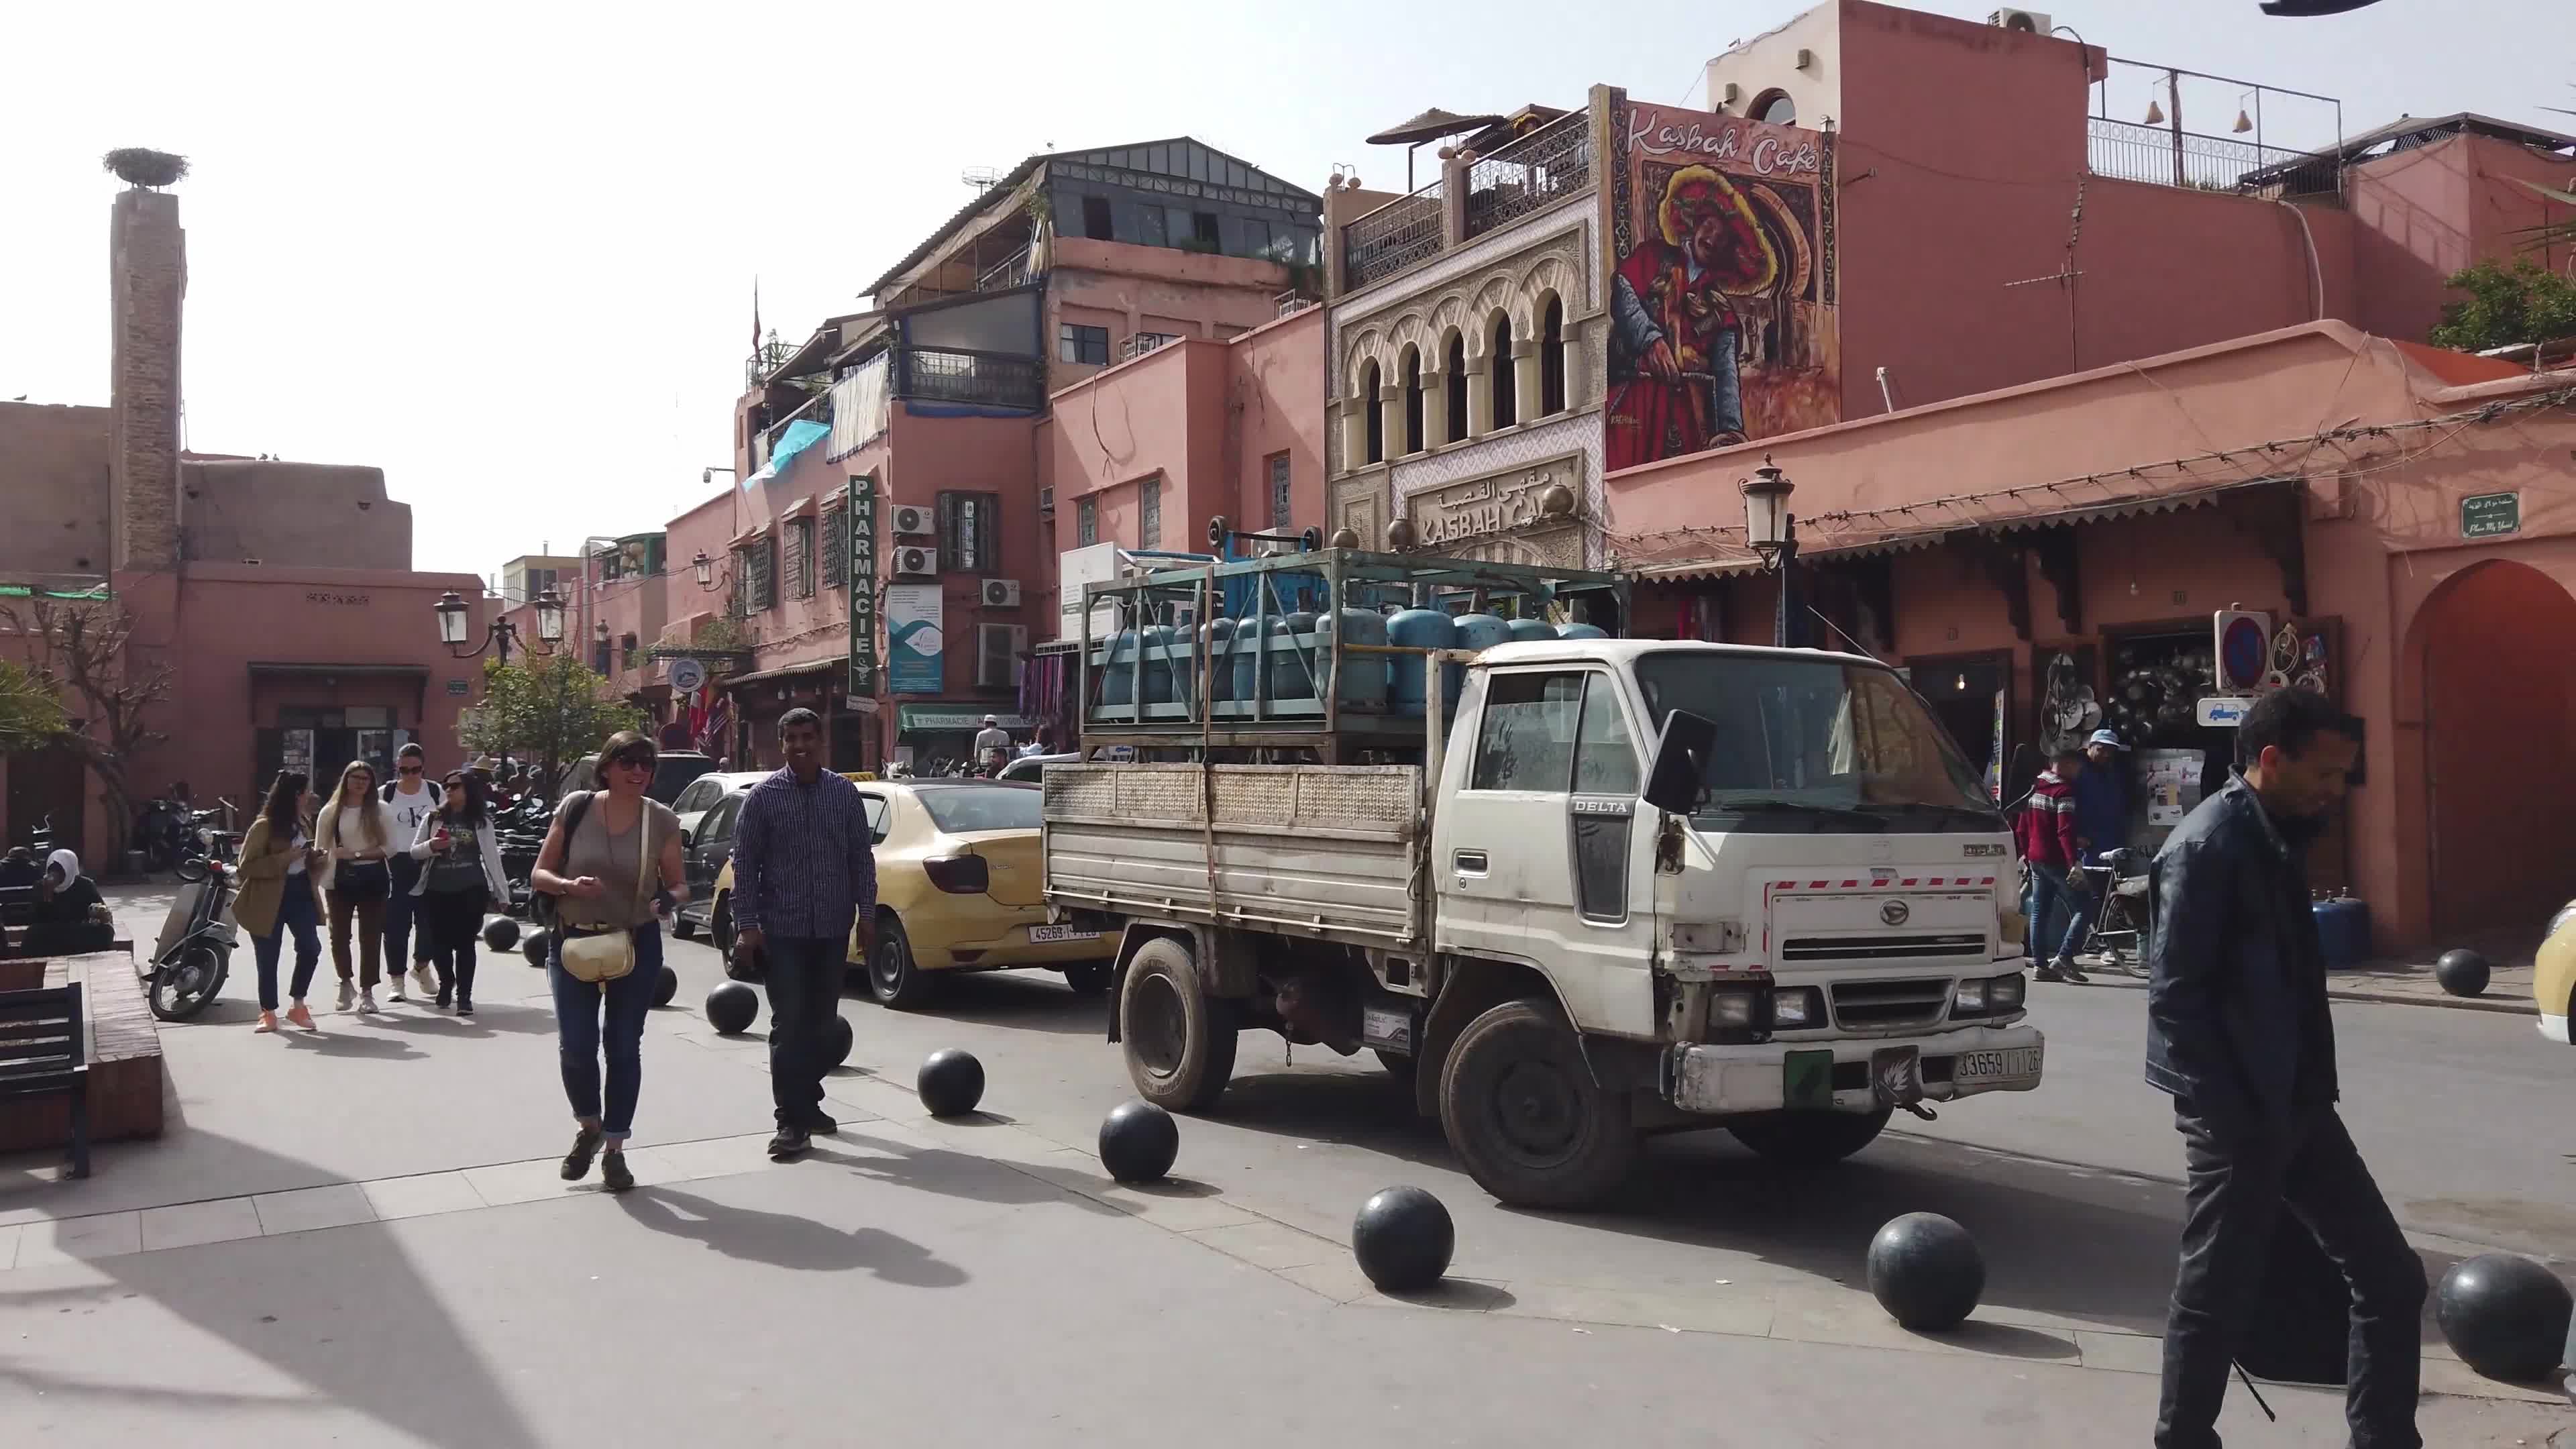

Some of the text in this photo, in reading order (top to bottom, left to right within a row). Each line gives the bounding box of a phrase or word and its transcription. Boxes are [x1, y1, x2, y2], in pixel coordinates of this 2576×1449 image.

[1627, 107, 1820, 176] Kasbah Café
[1438, 470, 1550, 510] مقهى القصبة
[1421, 505, 1503, 545] KASBAH
[855, 480, 871, 653] PHARMACIE
[924, 716, 970, 726] PHARMACIE
[1574, 801, 1628, 812] DELTA
